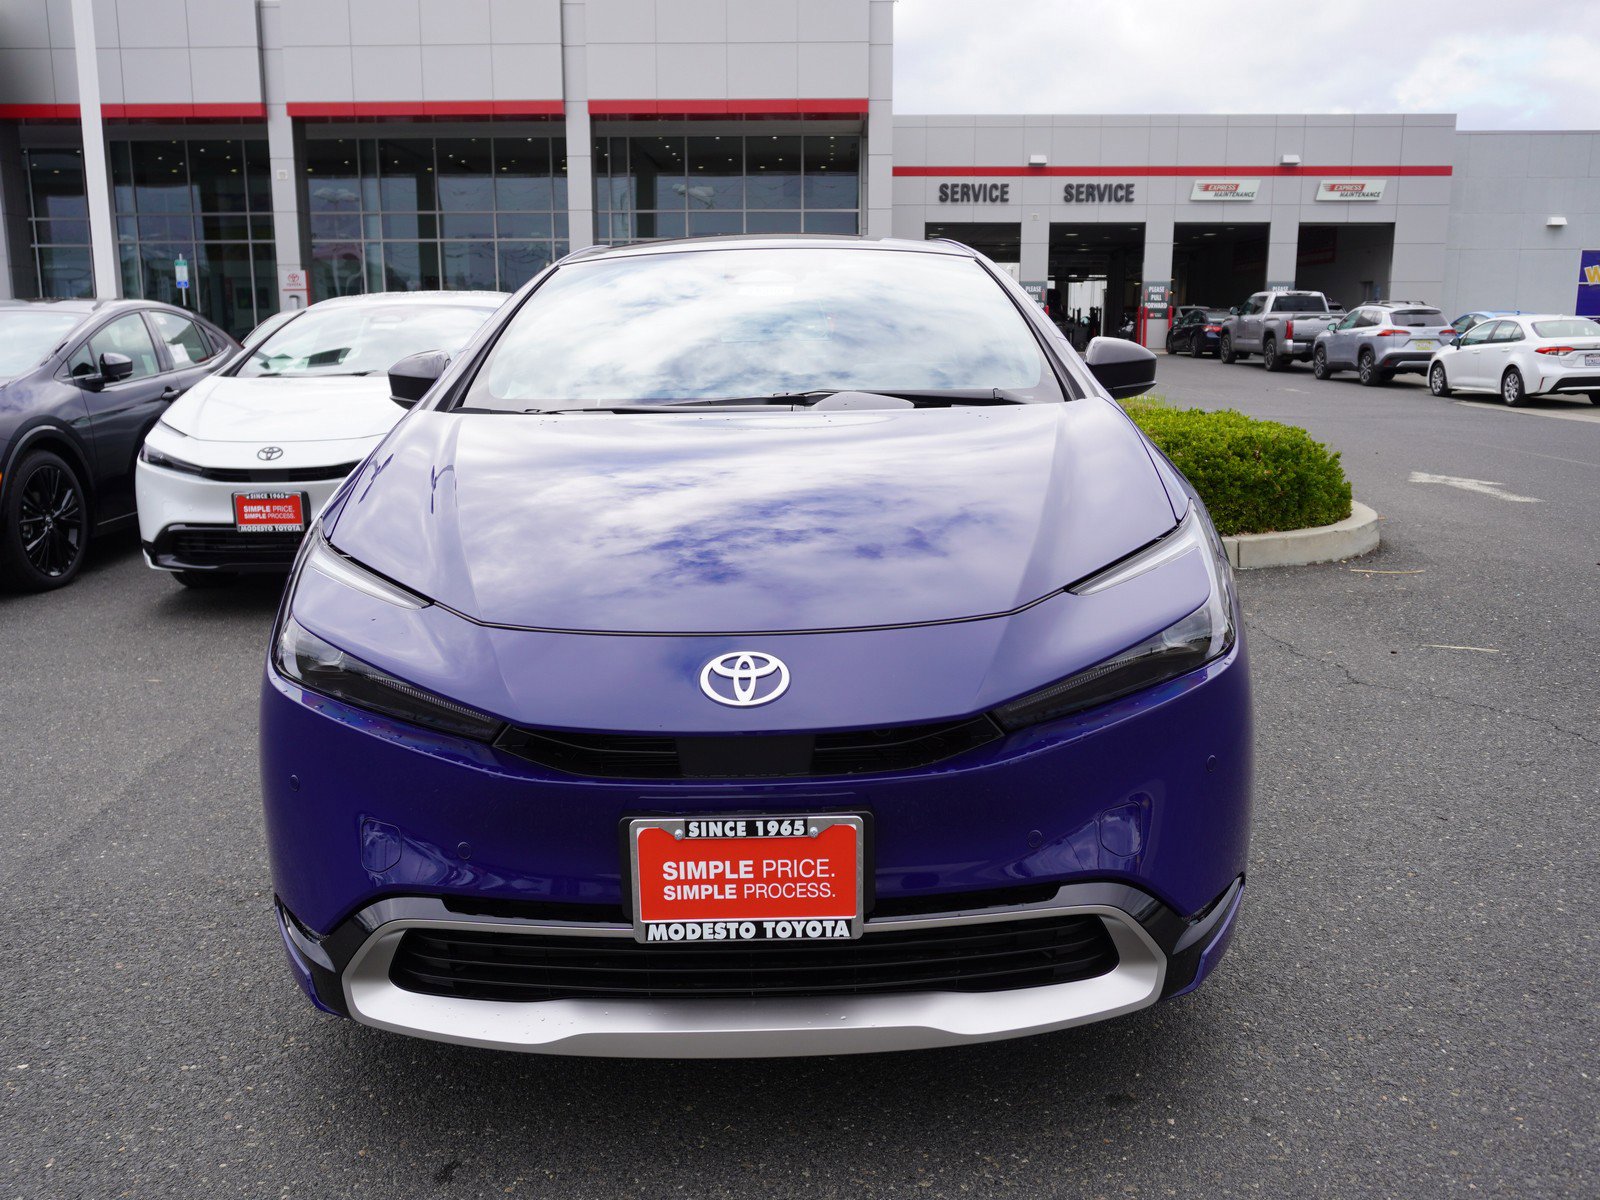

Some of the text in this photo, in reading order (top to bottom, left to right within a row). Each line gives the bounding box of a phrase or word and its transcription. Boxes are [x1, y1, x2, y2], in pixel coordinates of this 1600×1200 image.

[939, 183, 1009, 203] SERVICE
[1064, 183, 1134, 203] SERVICE
[688, 820, 805, 837] SINCE 1965
[662, 858, 836, 881] SIMPLE PRICE.
[663, 882, 836, 901] SIMPLE PROCESS.
[647, 920, 850, 941] MODESTO TOYOTA
